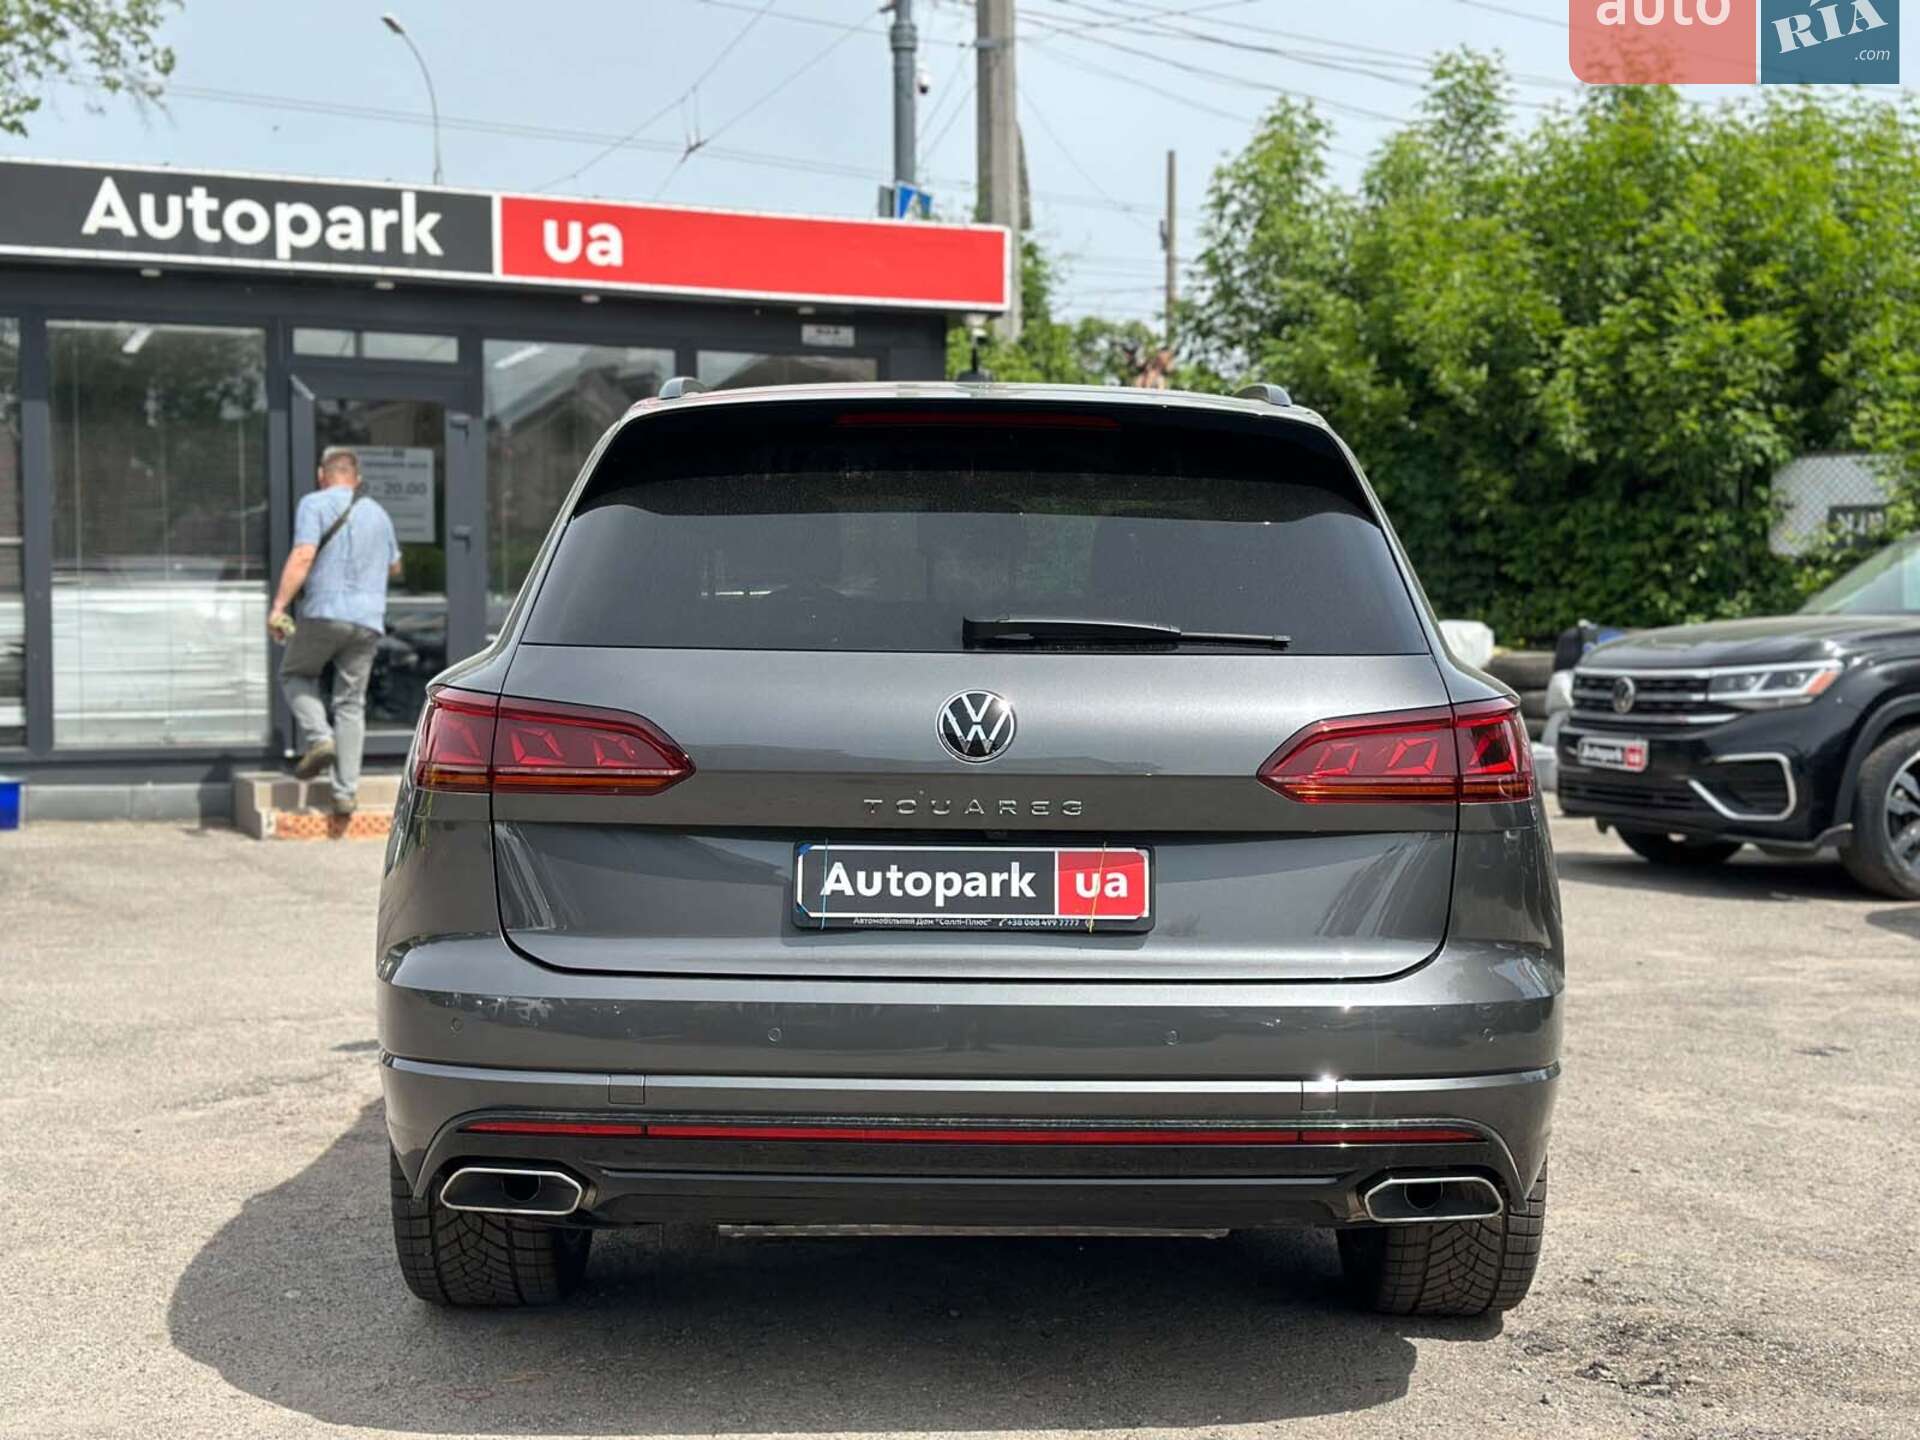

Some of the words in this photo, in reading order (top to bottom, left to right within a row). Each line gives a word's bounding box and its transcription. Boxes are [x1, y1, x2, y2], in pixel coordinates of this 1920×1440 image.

[81, 175, 443, 260] Autopark
[542, 216, 623, 267] ua
[863, 798, 1082, 816] TOUAREG
[820, 861, 1037, 907] Autopark
[1075, 871, 1129, 899] ua
